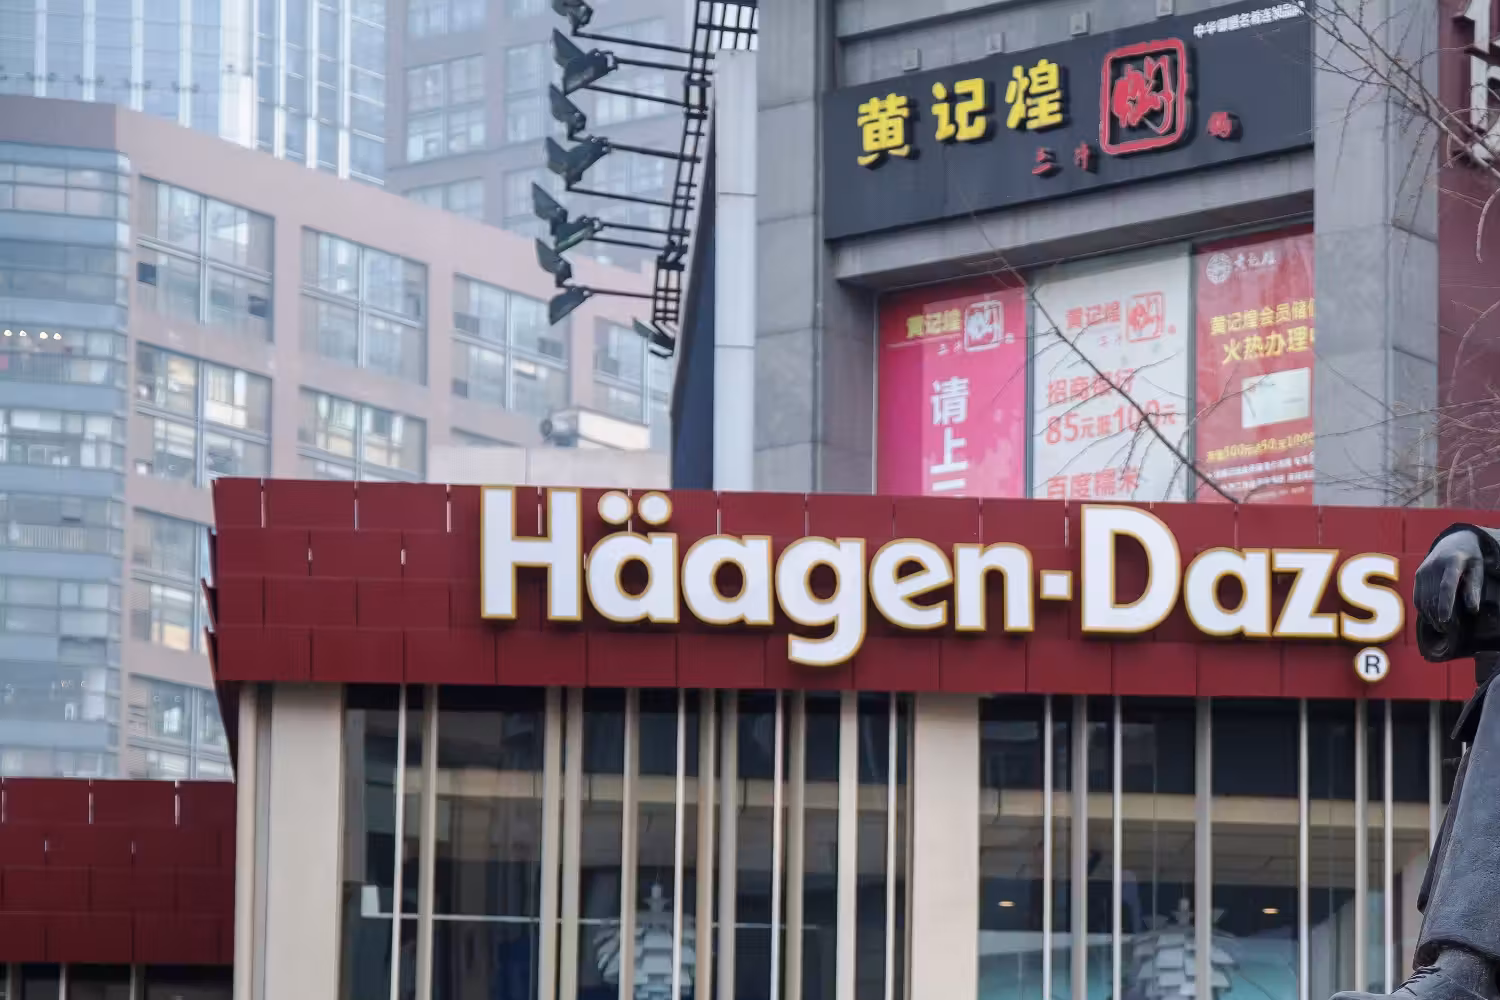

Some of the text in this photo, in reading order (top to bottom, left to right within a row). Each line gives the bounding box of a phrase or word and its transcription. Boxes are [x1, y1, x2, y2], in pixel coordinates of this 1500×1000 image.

[857, 58, 1064, 166] 黄记煌
[906, 308, 962, 339] 黄记煌
[1065, 301, 1121, 330] 黄记煌
[1221, 325, 1315, 365] 火热办理
[1047, 367, 1137, 405] 招商银行
[1047, 465, 1139, 500] 百度糯米
[479, 486, 1405, 666] Häagen-Dazs
